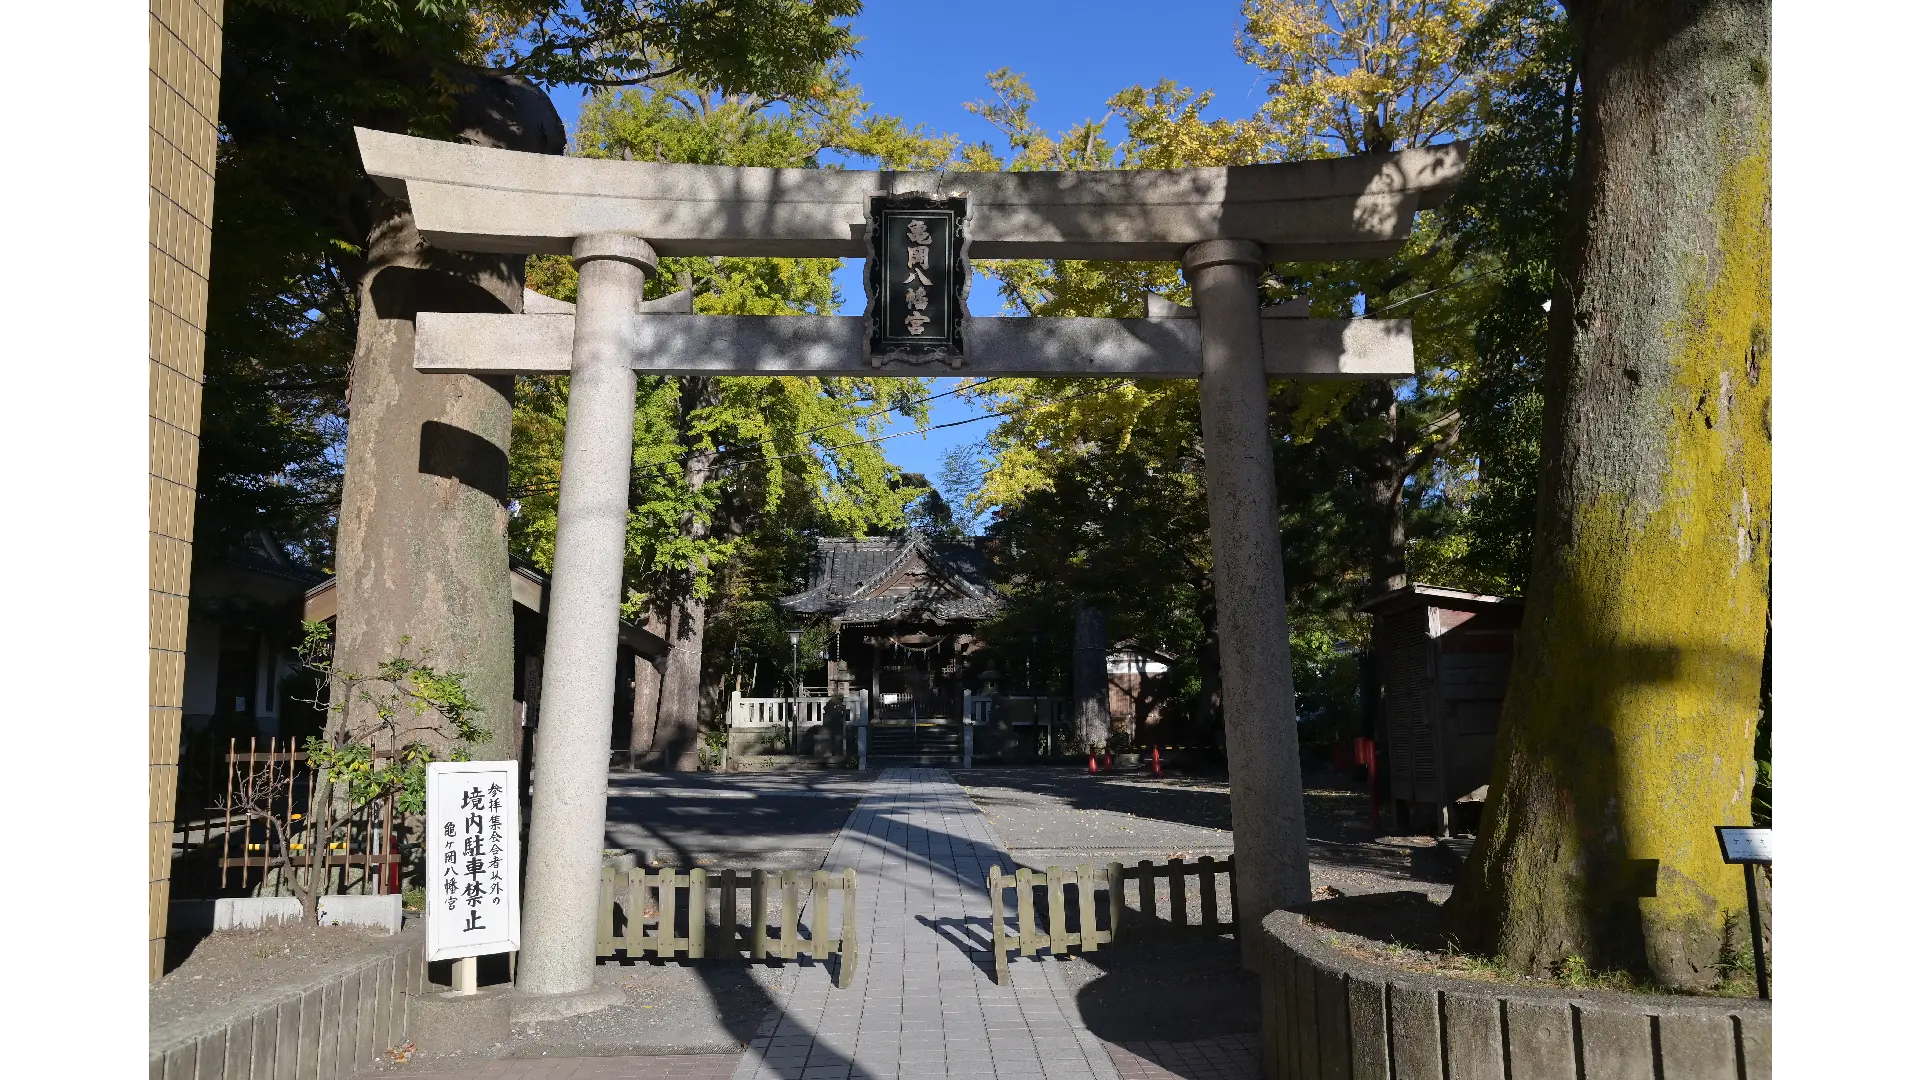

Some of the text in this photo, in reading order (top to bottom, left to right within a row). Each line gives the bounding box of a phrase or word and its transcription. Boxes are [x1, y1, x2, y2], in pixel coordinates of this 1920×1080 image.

[461, 786, 487, 932] 境内駐車禁止
